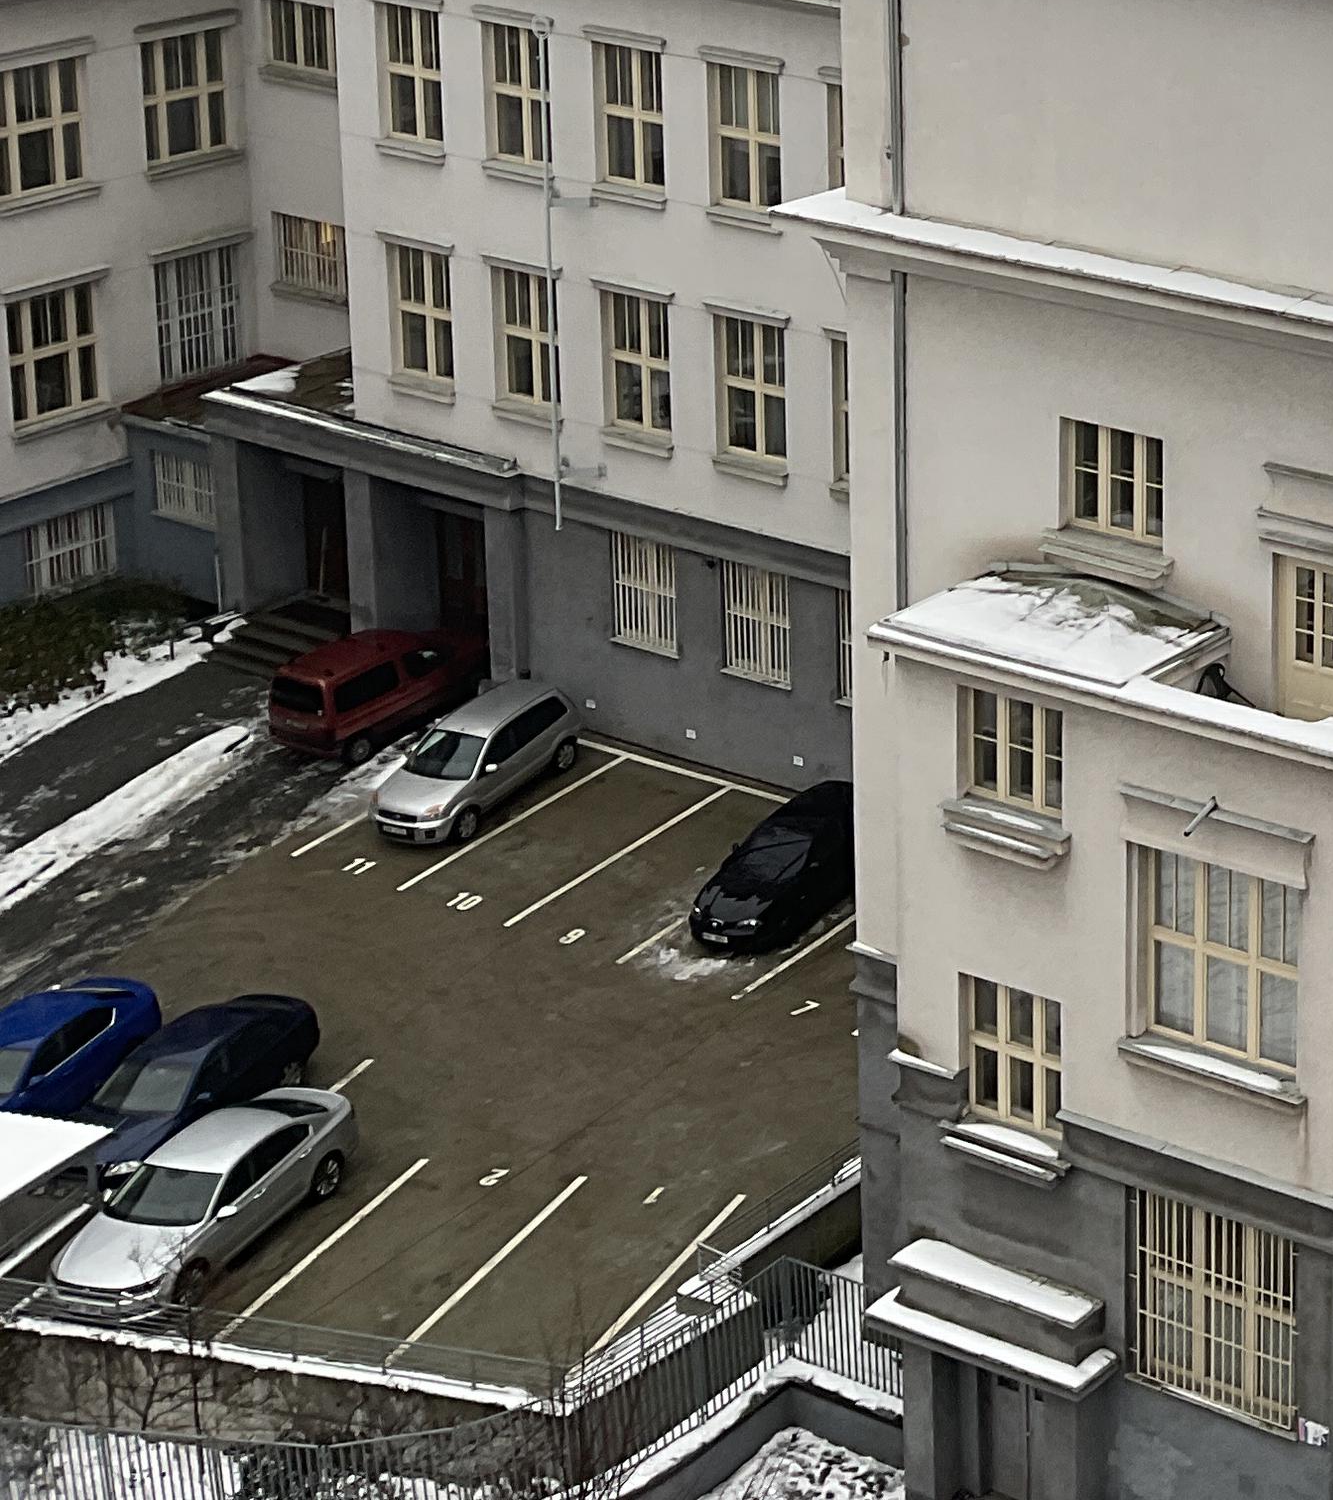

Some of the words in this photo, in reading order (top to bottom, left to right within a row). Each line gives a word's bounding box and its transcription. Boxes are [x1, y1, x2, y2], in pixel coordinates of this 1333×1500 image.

[341, 857, 377, 875] 11
[446, 891, 483, 911] 10
[558, 928, 586, 945] 9
[478, 1168, 511, 1187] 2
